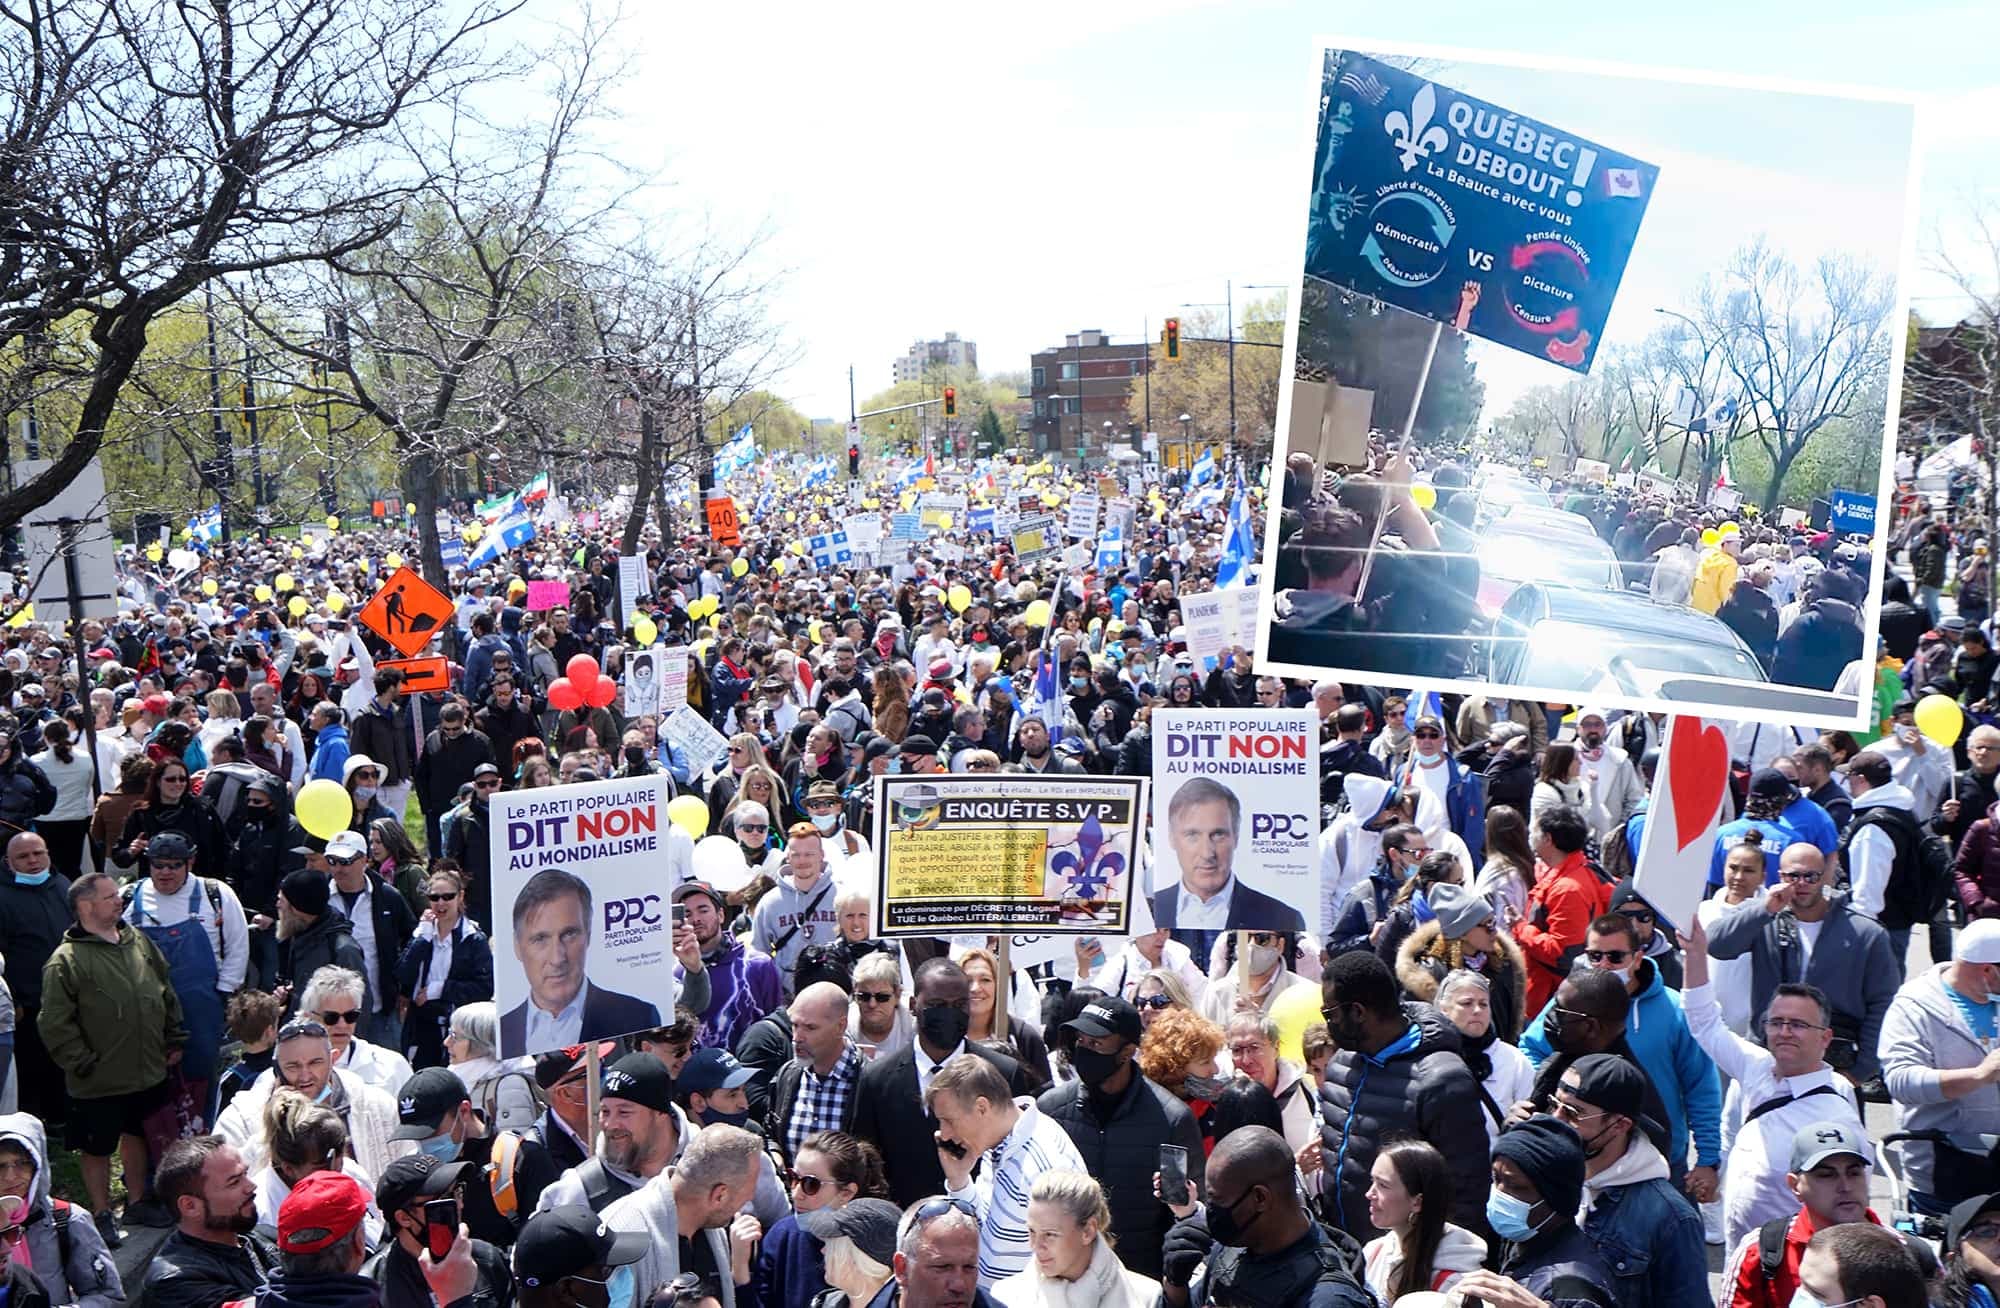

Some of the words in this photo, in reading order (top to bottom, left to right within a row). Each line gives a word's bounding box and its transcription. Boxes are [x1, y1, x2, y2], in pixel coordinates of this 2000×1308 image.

[1448, 101, 1577, 170] QUÉBEC
[1376, 181, 1409, 197] Liberté
[1410, 181, 1456, 225] d'expression
[1426, 162, 1444, 178] La
[1447, 170, 1499, 199] Beauce
[1502, 191, 1536, 212] avec
[1538, 207, 1573, 227] vous
[1375, 222, 1440, 254] Démocratie
[1526, 230, 1562, 244] Pensée
[1563, 234, 1591, 265] Unique
[1468, 247, 1495, 272] VS
[1522, 275, 1575, 301] Dictature
[1513, 303, 1553, 324] Censure
[711, 509, 733, 528] 40
[1167, 721, 1183, 732] Le
[1186, 721, 1226, 732] PARTI
[1229, 721, 1307, 732] POPULAIRE
[1167, 734, 1222, 758] DIT
[1229, 735, 1307, 759] NON
[1167, 761, 1188, 774] AU
[1193, 762, 1307, 775] MONDIALISME
[507, 804, 526, 820] Le
[530, 799, 573, 816] PARTI
[576, 789, 656, 811] POPULAIRE
[946, 799, 1051, 819] ENQUÊTE
[508, 815, 569, 851] DIT
[577, 805, 656, 842] NON
[939, 832, 981, 841] JUSTIFIE
[994, 831, 1038, 841] POUVOIR
[1252, 813, 1309, 840] PPC
[509, 853, 533, 871] AU
[538, 836, 657, 867] MONDIALISME
[1271, 840, 1310, 848] POPULAIRE
[919, 865, 977, 873] OPPOSITION
[930, 854, 945, 862] PM
[946, 853, 979, 864] Legault
[603, 895, 662, 932] PPC
[892, 906, 904, 914] La
[904, 905, 953, 913] dominance
[954, 905, 969, 913] par
[970, 904, 1014, 912] DÉCRETS
[1014, 904, 1026, 912] de
[1027, 904, 1060, 913] Legault
[896, 915, 917, 923] TUE
[917, 914, 928, 922] le
[927, 914, 965, 922] Québec
[604, 930, 625, 940] PARTI
[625, 923, 662, 936] POPULAIRE
[613, 935, 643, 947] CANADA
[606, 1079, 620, 1091] 41
